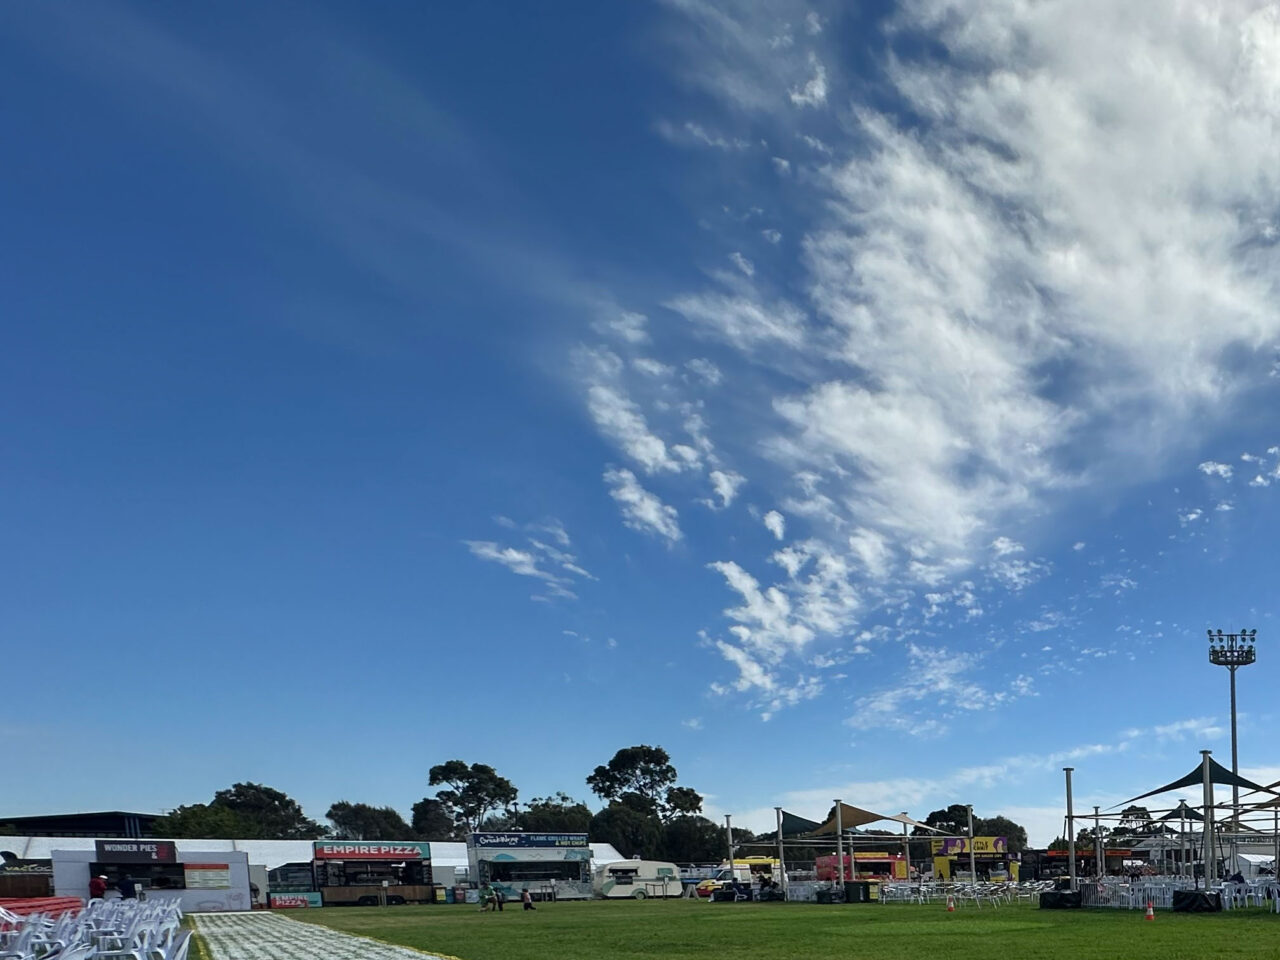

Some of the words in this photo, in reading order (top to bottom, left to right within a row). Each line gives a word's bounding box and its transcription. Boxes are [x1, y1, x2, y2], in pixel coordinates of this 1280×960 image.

[104, 844, 138, 852] WONDER
[140, 844, 158, 852] PIES
[322, 845, 379, 854] EMPIRE
[380, 845, 423, 854] PIZZA
